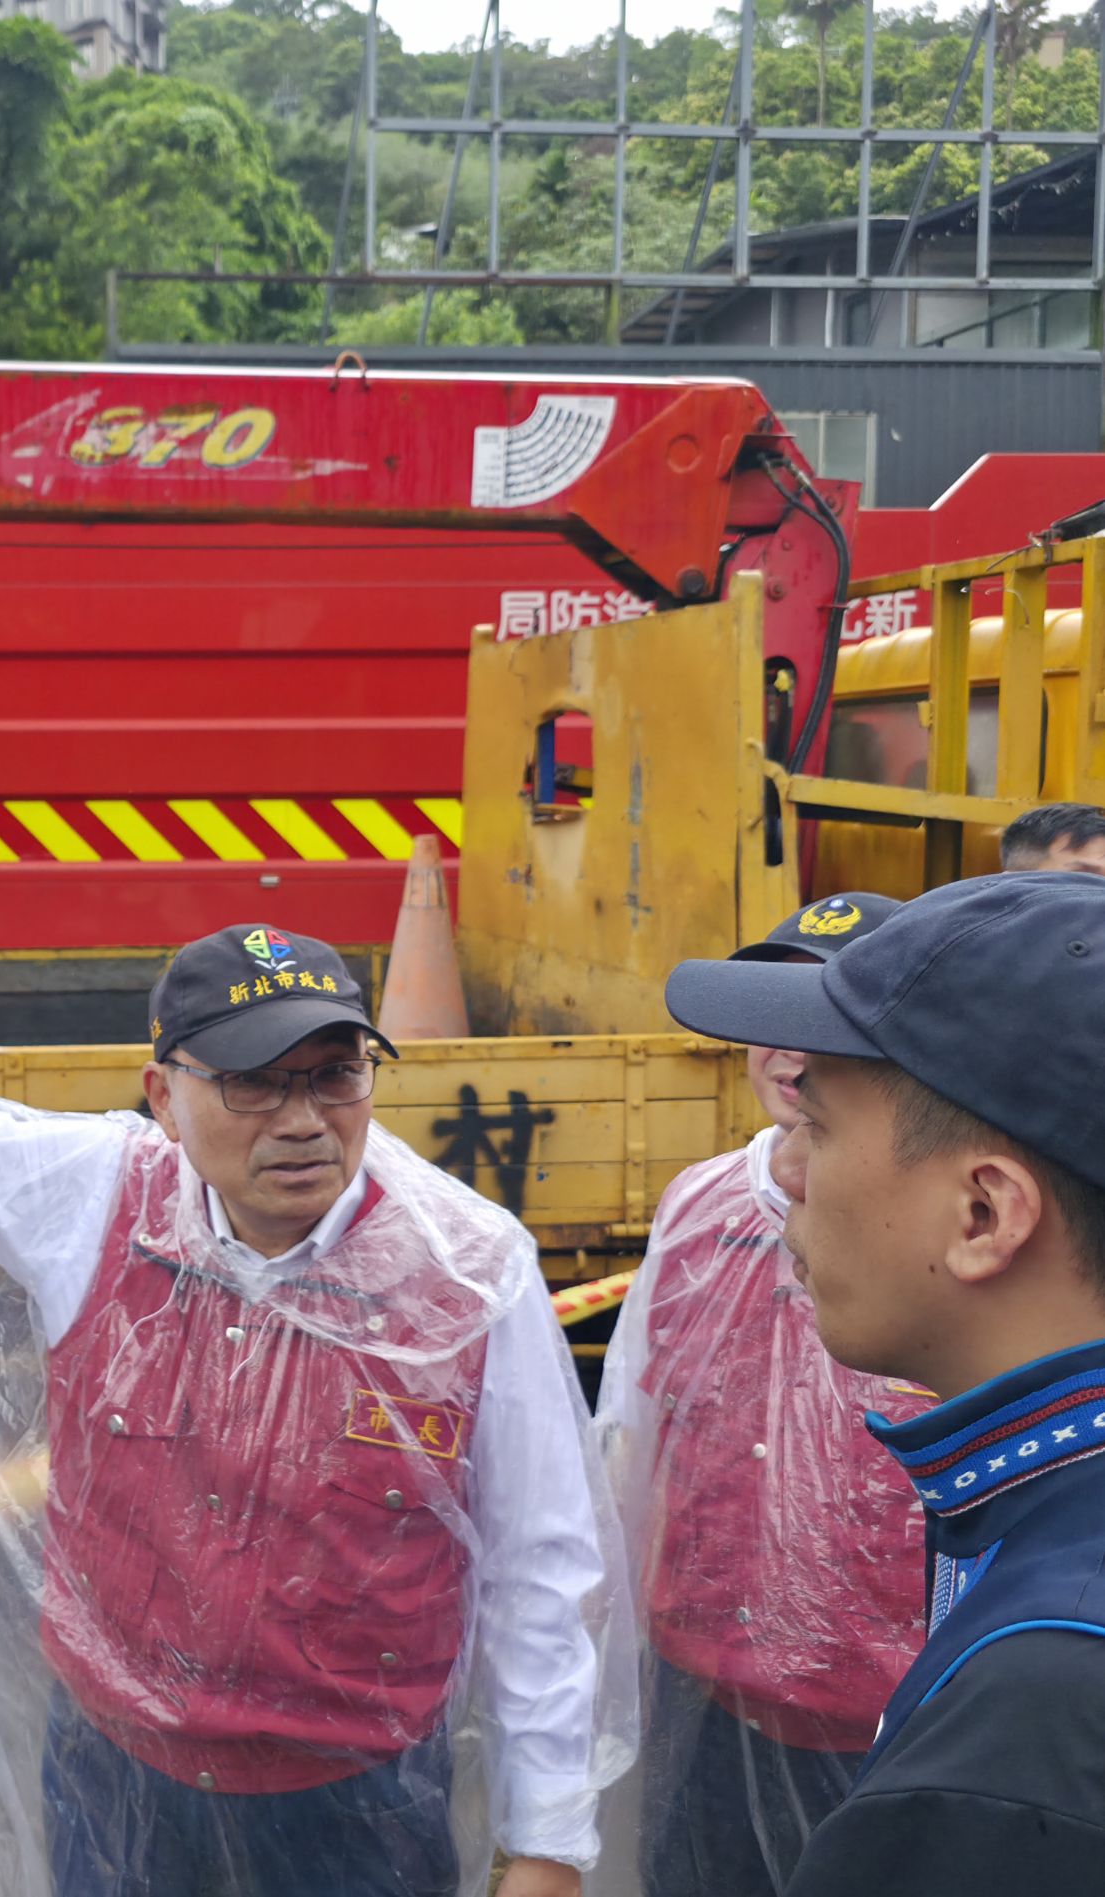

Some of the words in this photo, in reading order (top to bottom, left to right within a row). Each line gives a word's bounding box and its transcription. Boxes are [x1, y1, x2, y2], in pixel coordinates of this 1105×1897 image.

[70, 406, 276, 468] 370
[229, 970, 338, 1005] 新北市政府
[366, 1403, 442, 1446] 市長
